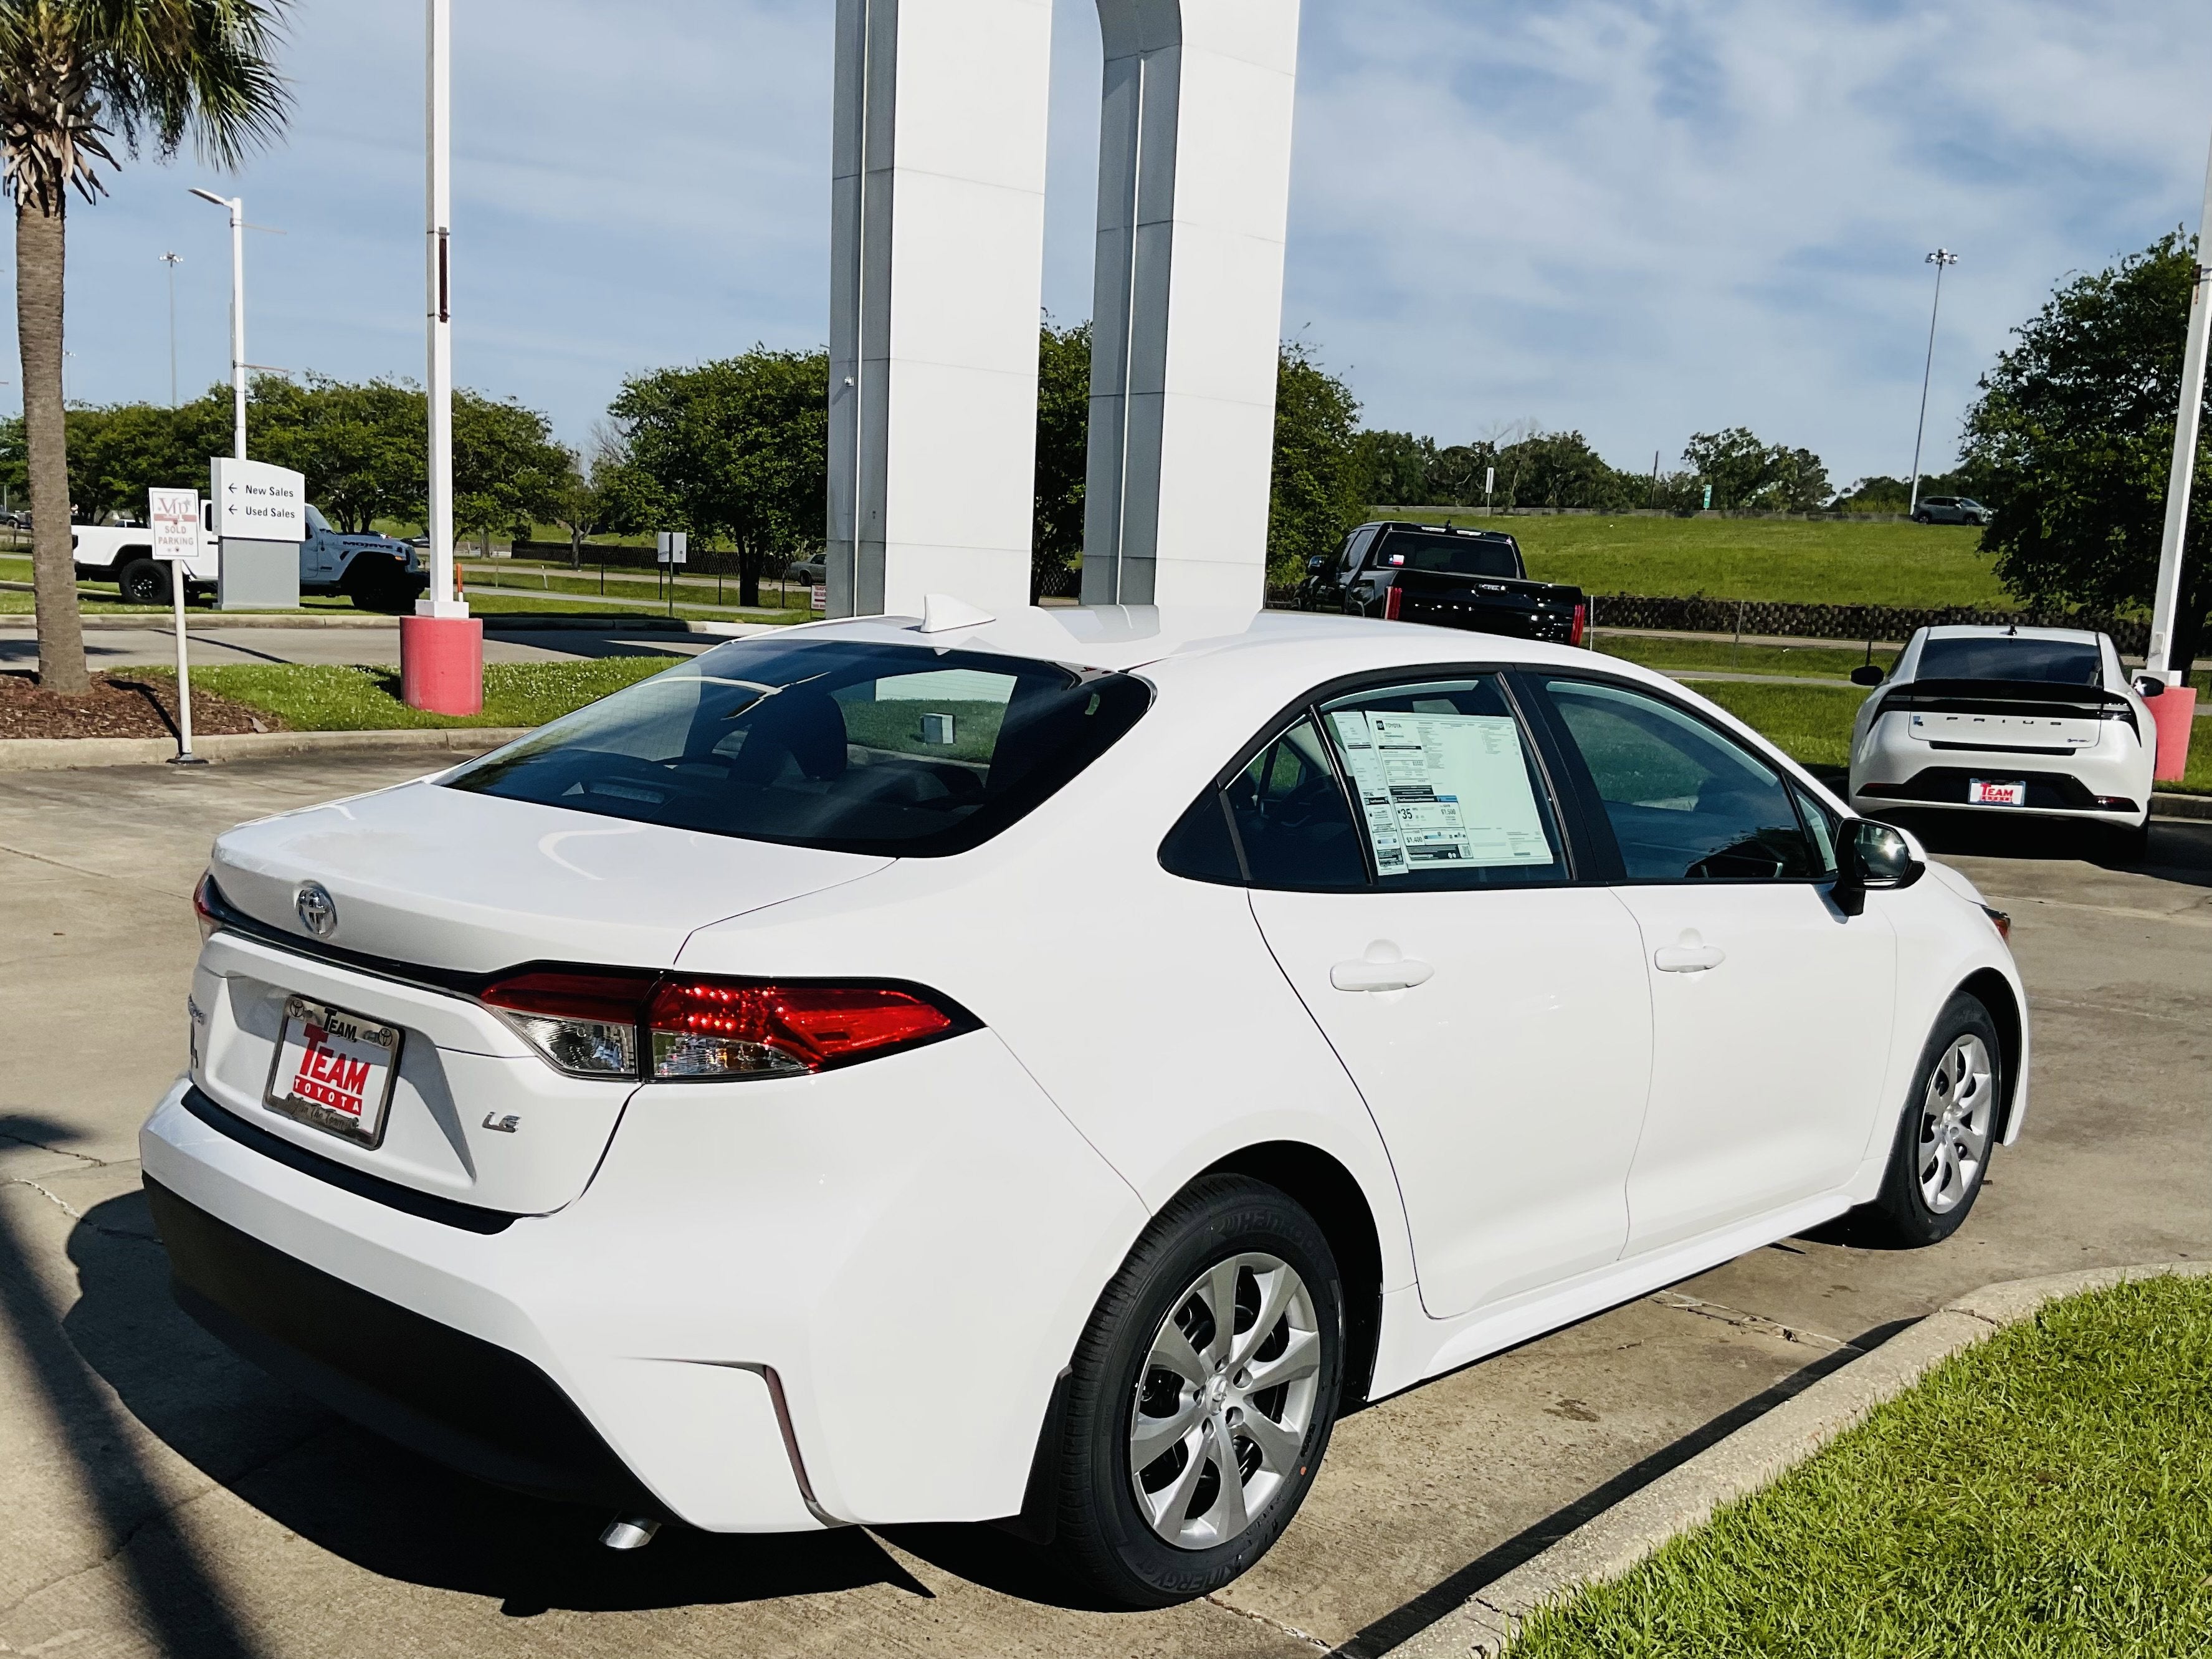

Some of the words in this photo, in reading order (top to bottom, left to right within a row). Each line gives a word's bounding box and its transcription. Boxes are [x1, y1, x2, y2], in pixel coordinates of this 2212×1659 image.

[246, 485, 267, 495] New
[269, 486, 293, 497] Sales
[246, 506, 268, 516] Used
[270, 507, 295, 519] Sales
[164, 525, 187, 534] SOLD
[158, 537, 194, 545] PARKING
[1947, 717, 2061, 725] PRIUS
[1980, 782, 2013, 796] TEAM
[1401, 809, 1413, 820] 35
[323, 1007, 357, 1041] TEAM
[300, 1023, 371, 1096] TEAM
[295, 1079, 360, 1113] TOYOTA
[482, 1111, 521, 1133] LE
